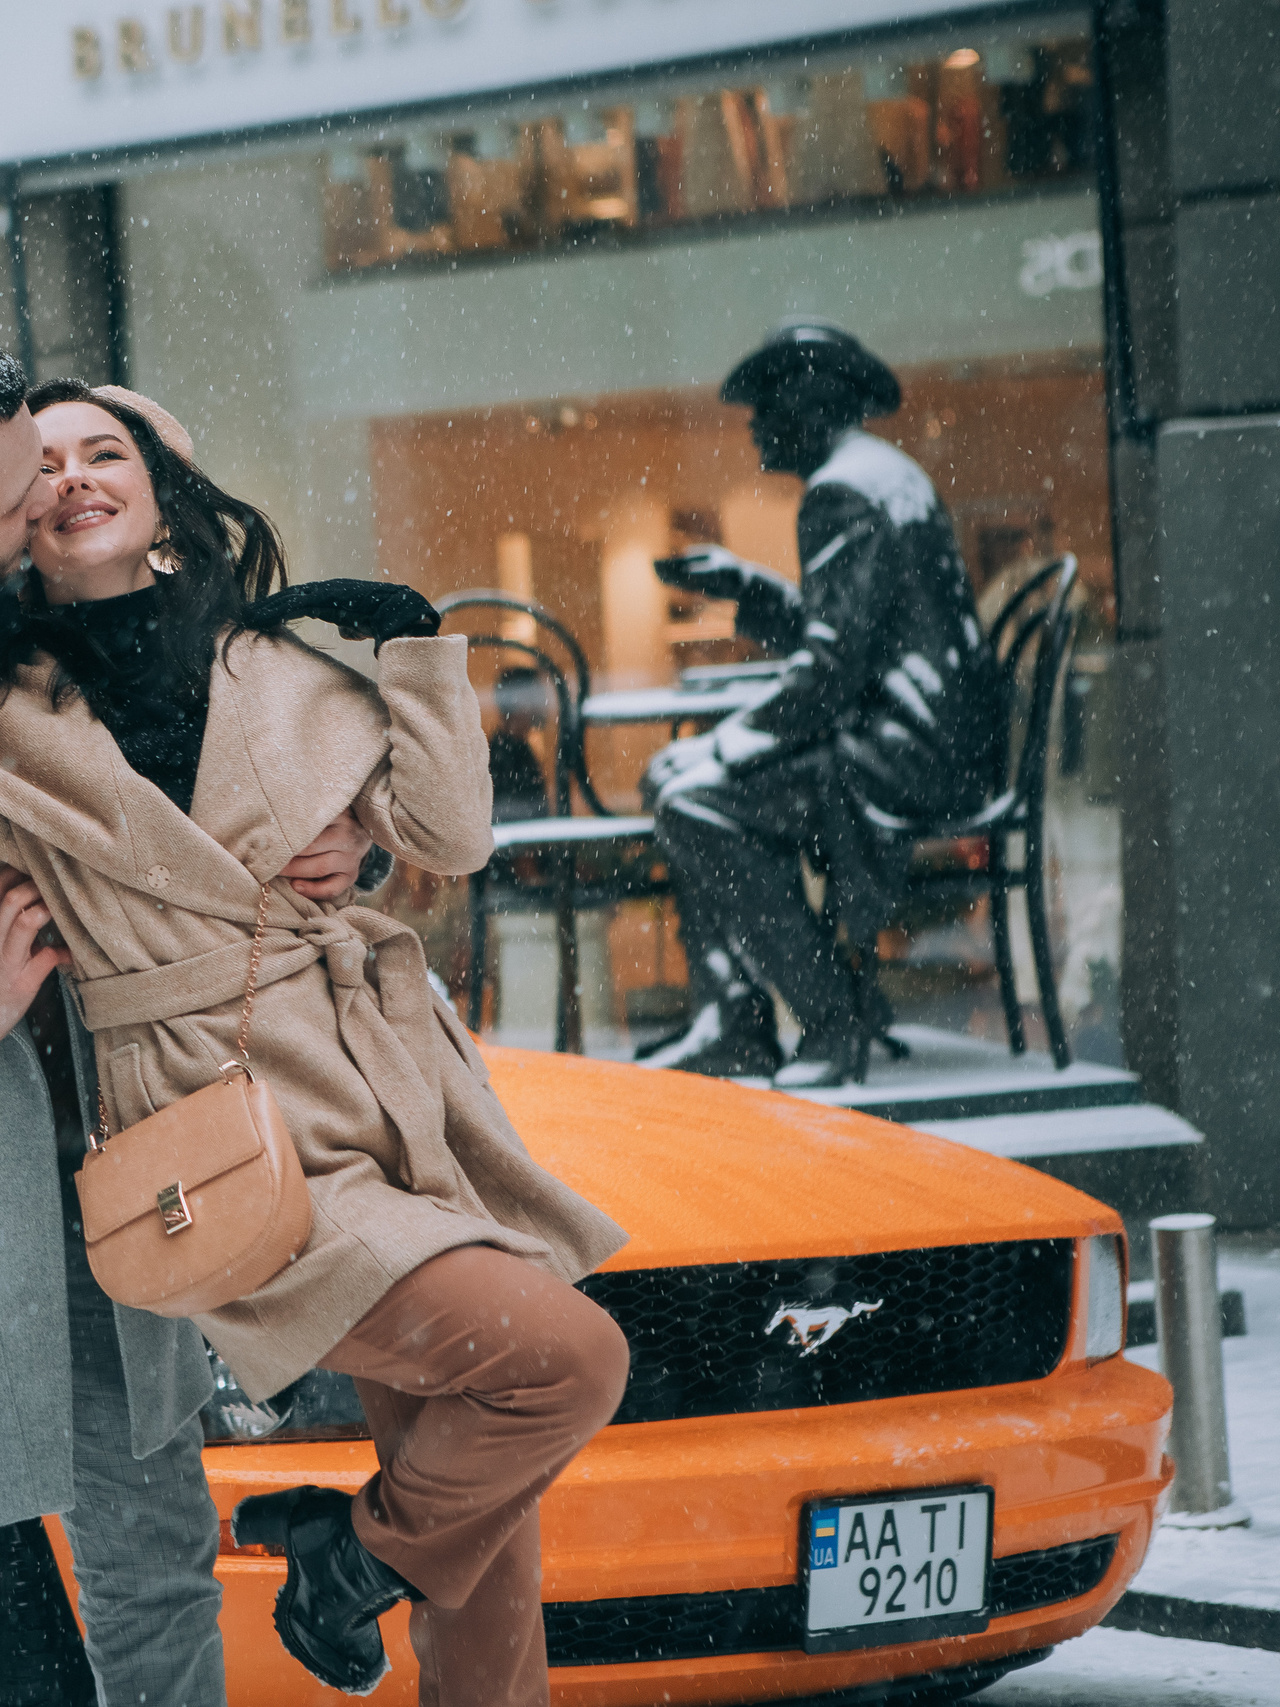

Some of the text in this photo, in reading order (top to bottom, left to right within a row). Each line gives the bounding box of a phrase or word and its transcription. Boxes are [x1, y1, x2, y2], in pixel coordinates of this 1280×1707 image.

[813, 1547, 835, 1567] UA
[844, 1501, 966, 1564] AA TI
[858, 1557, 958, 1617] 9210
